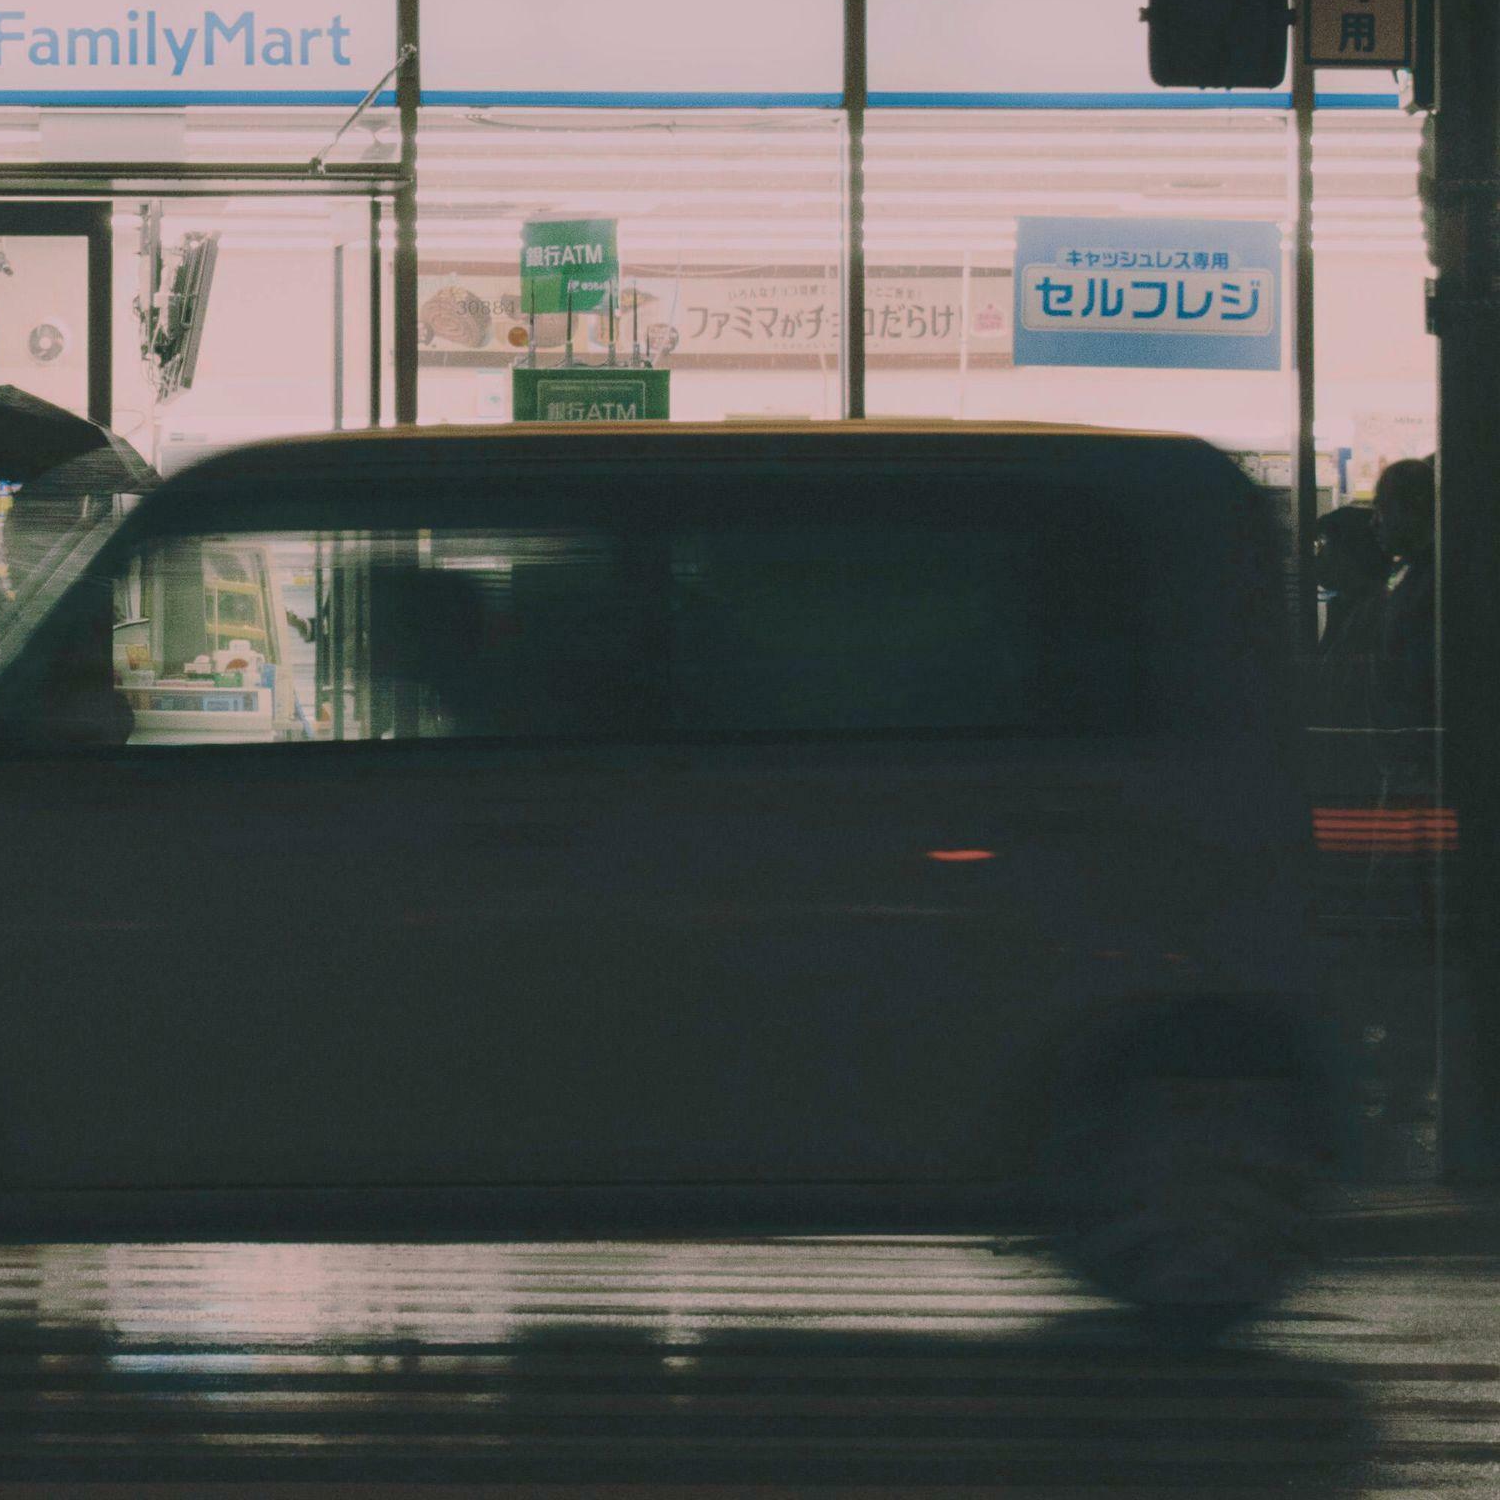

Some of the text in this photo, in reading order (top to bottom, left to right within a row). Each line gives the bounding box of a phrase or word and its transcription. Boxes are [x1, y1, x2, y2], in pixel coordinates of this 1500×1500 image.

[526, 244, 603, 267] 銀行ATM
[1064, 249, 1229, 270] キャッシュレス専用
[1035, 276, 1262, 321] セルフレジ
[547, 401, 637, 420] 銀行ATM
